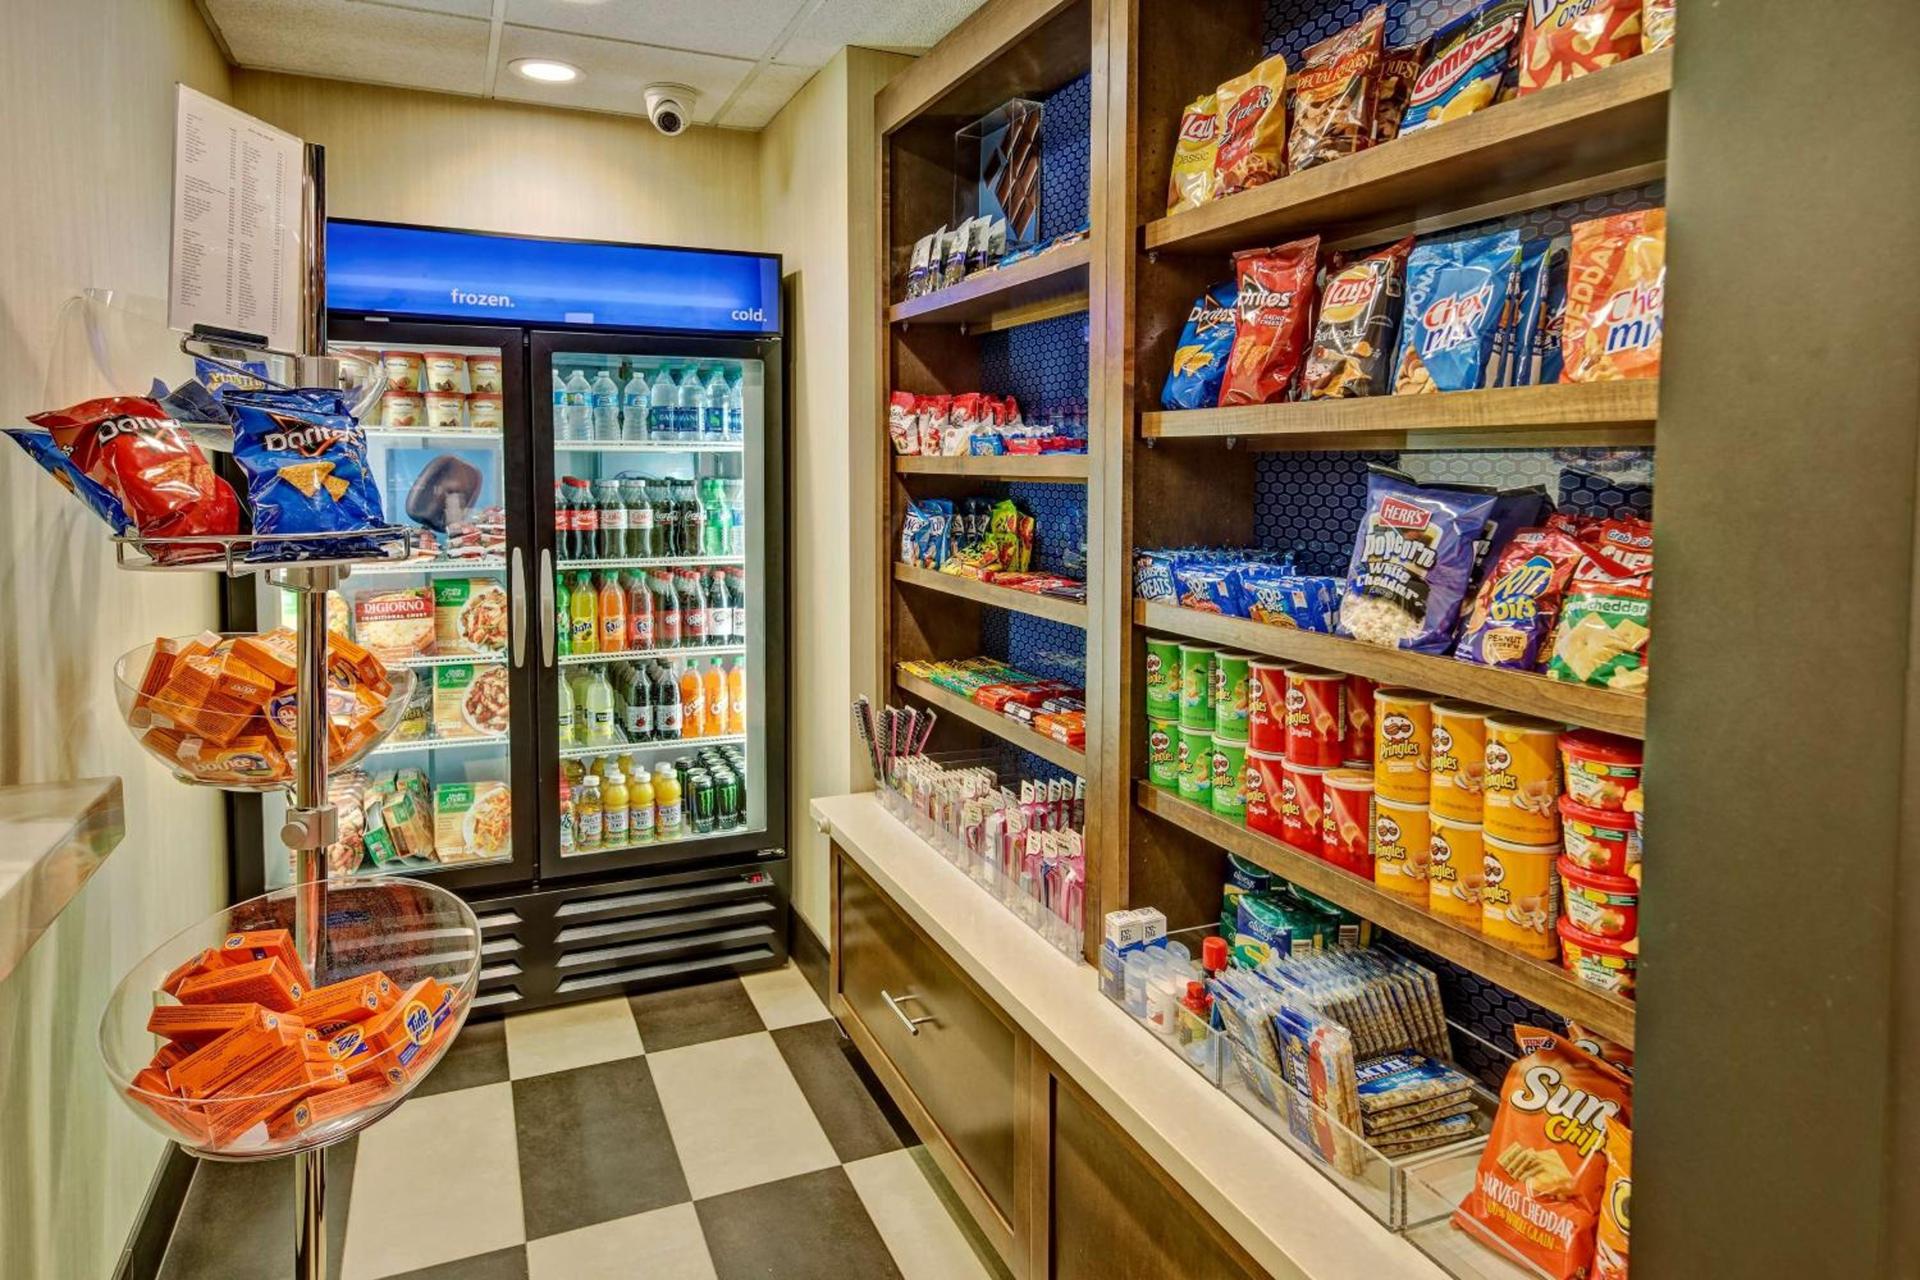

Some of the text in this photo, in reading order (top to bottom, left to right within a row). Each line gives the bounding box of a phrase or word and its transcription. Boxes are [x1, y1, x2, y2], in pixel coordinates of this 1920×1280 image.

[451, 290, 767, 323] frozen. cold.
[1606, 286, 1662, 323] Che
[1384, 504, 1425, 525] HERR'S
[364, 600, 425, 614] DIGIORNO
[1379, 740, 1419, 759] Pringles
[407, 1008, 429, 1032] Tide
[1511, 1066, 1620, 1132] Sun
[1544, 1115, 1606, 1157] Chip
